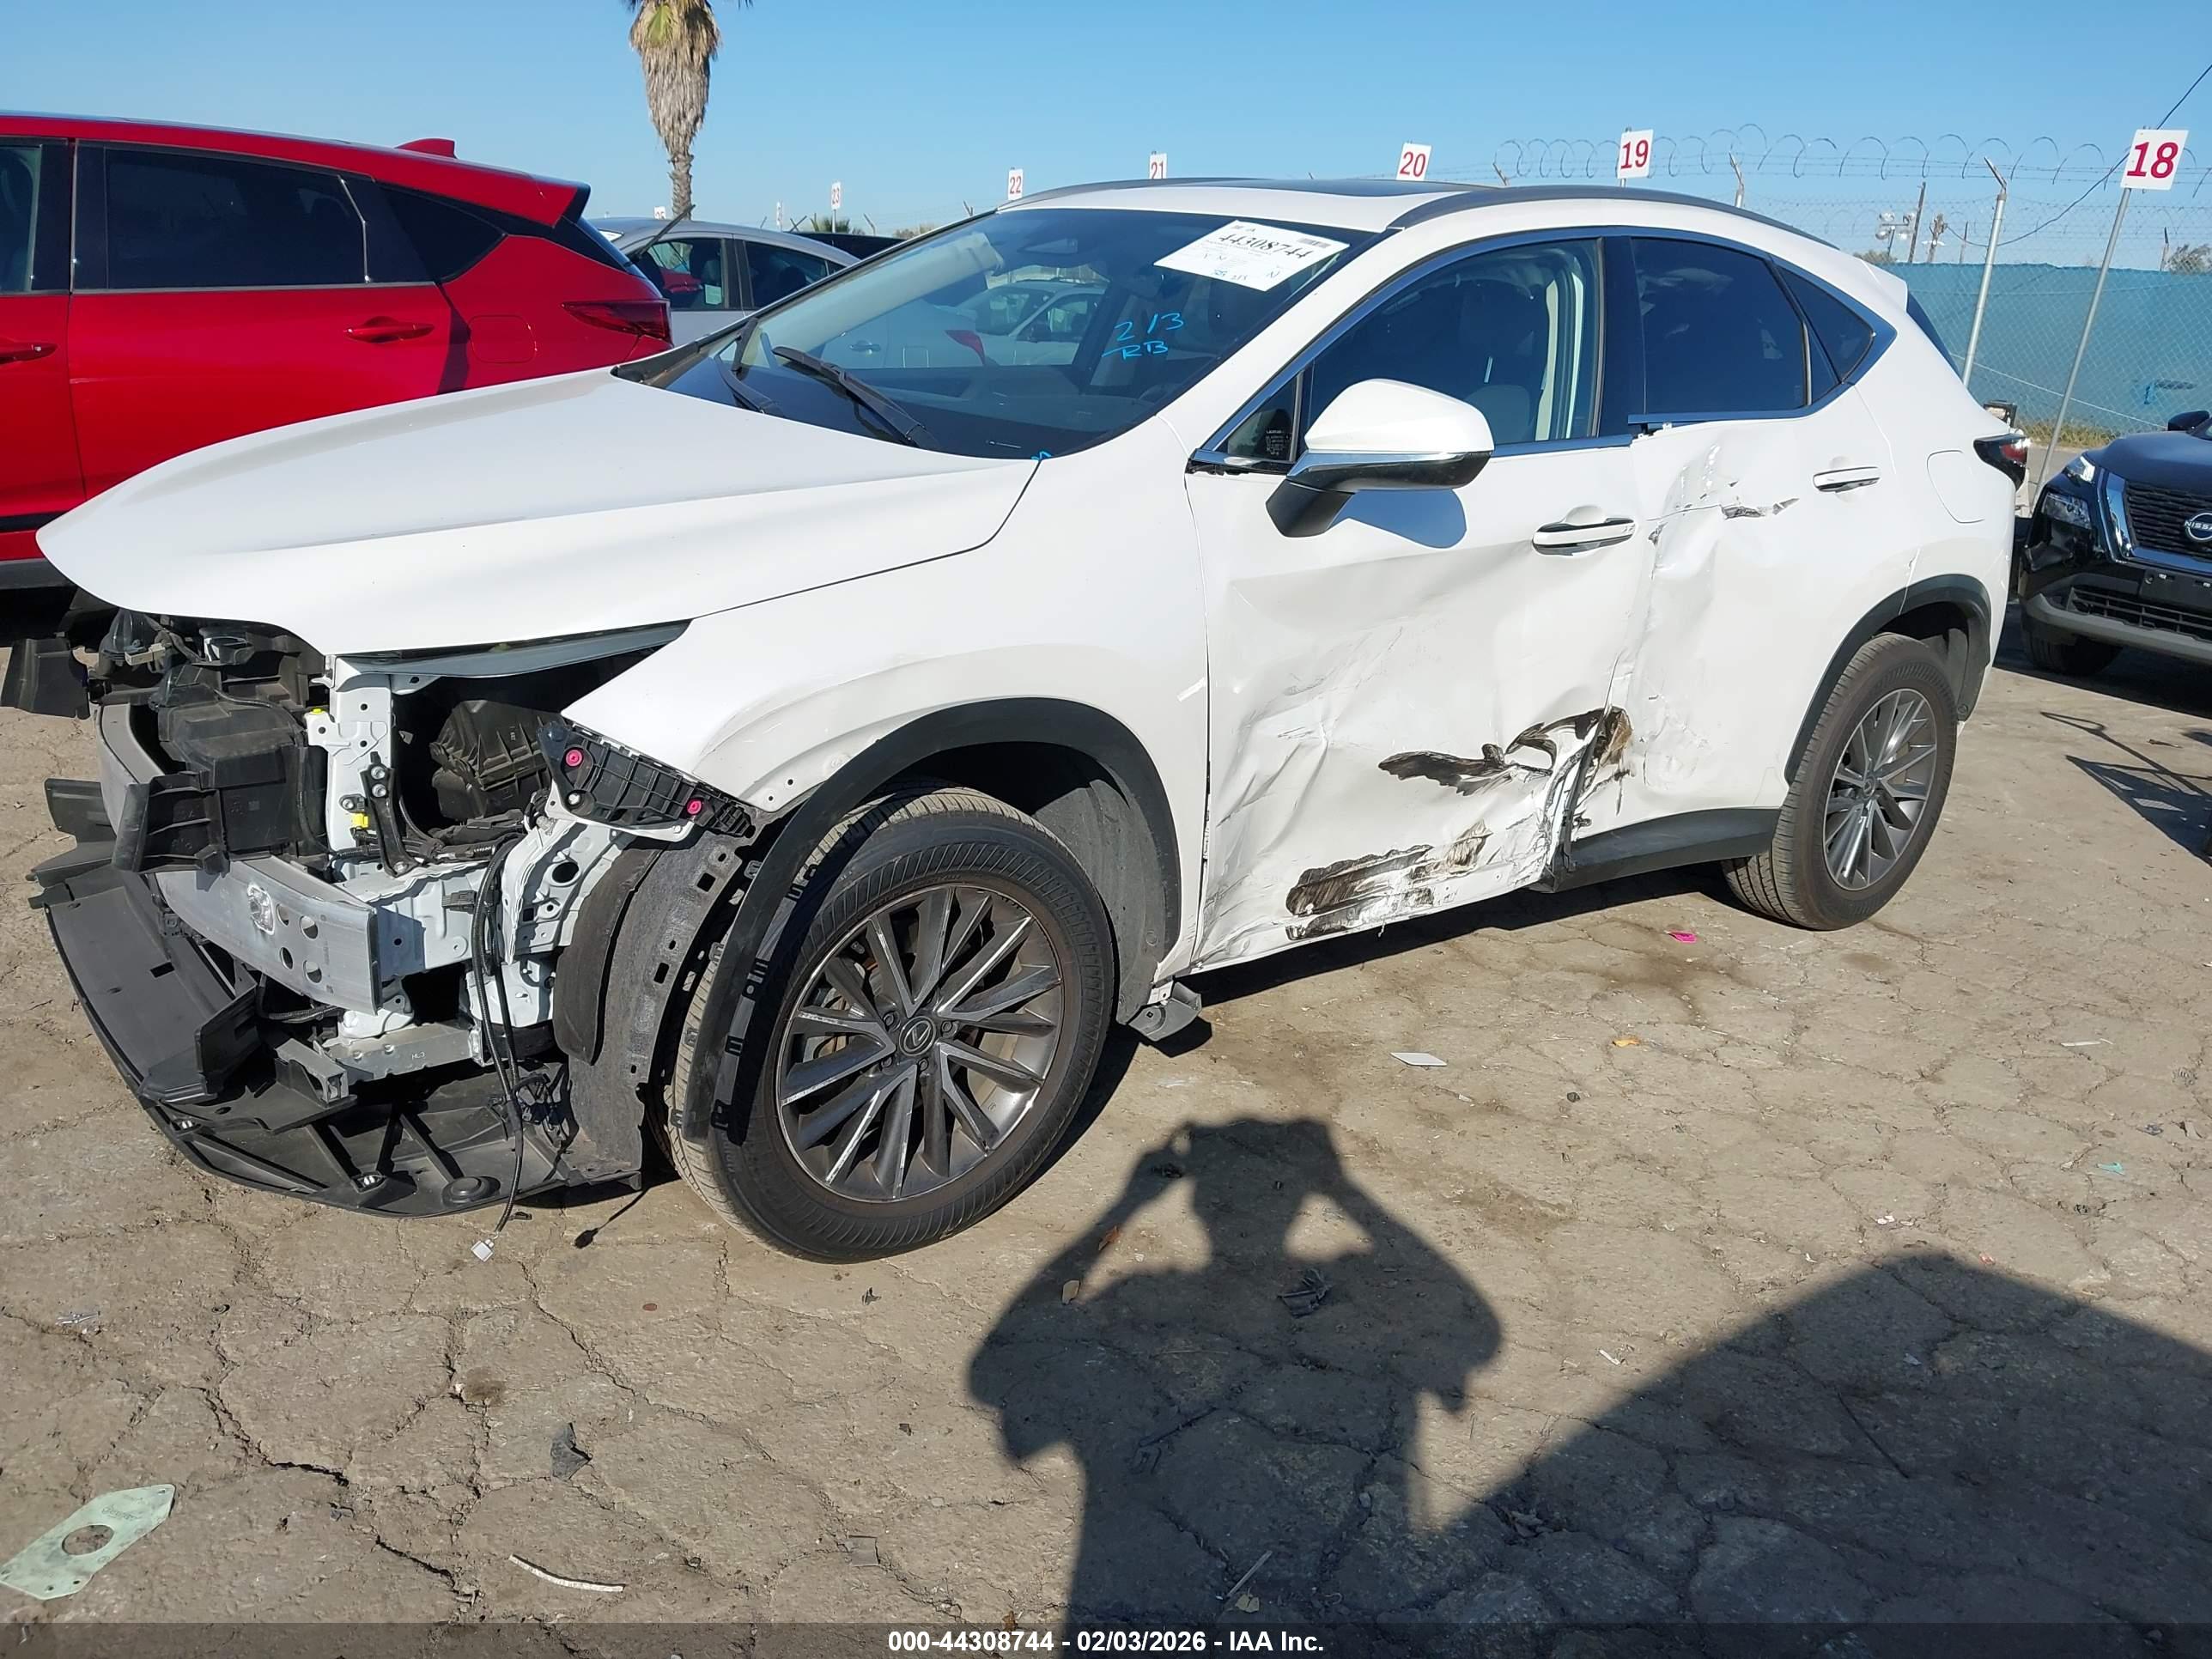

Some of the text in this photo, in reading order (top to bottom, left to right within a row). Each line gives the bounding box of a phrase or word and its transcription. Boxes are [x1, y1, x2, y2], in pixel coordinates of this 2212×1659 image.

[1400, 151, 1425, 178] 20
[1621, 140, 1649, 168] 19
[2126, 142, 2179, 179] 18
[1151, 161, 1164, 179] 21
[1009, 175, 1021, 194] 22
[1218, 234, 1314, 259] 44308744
